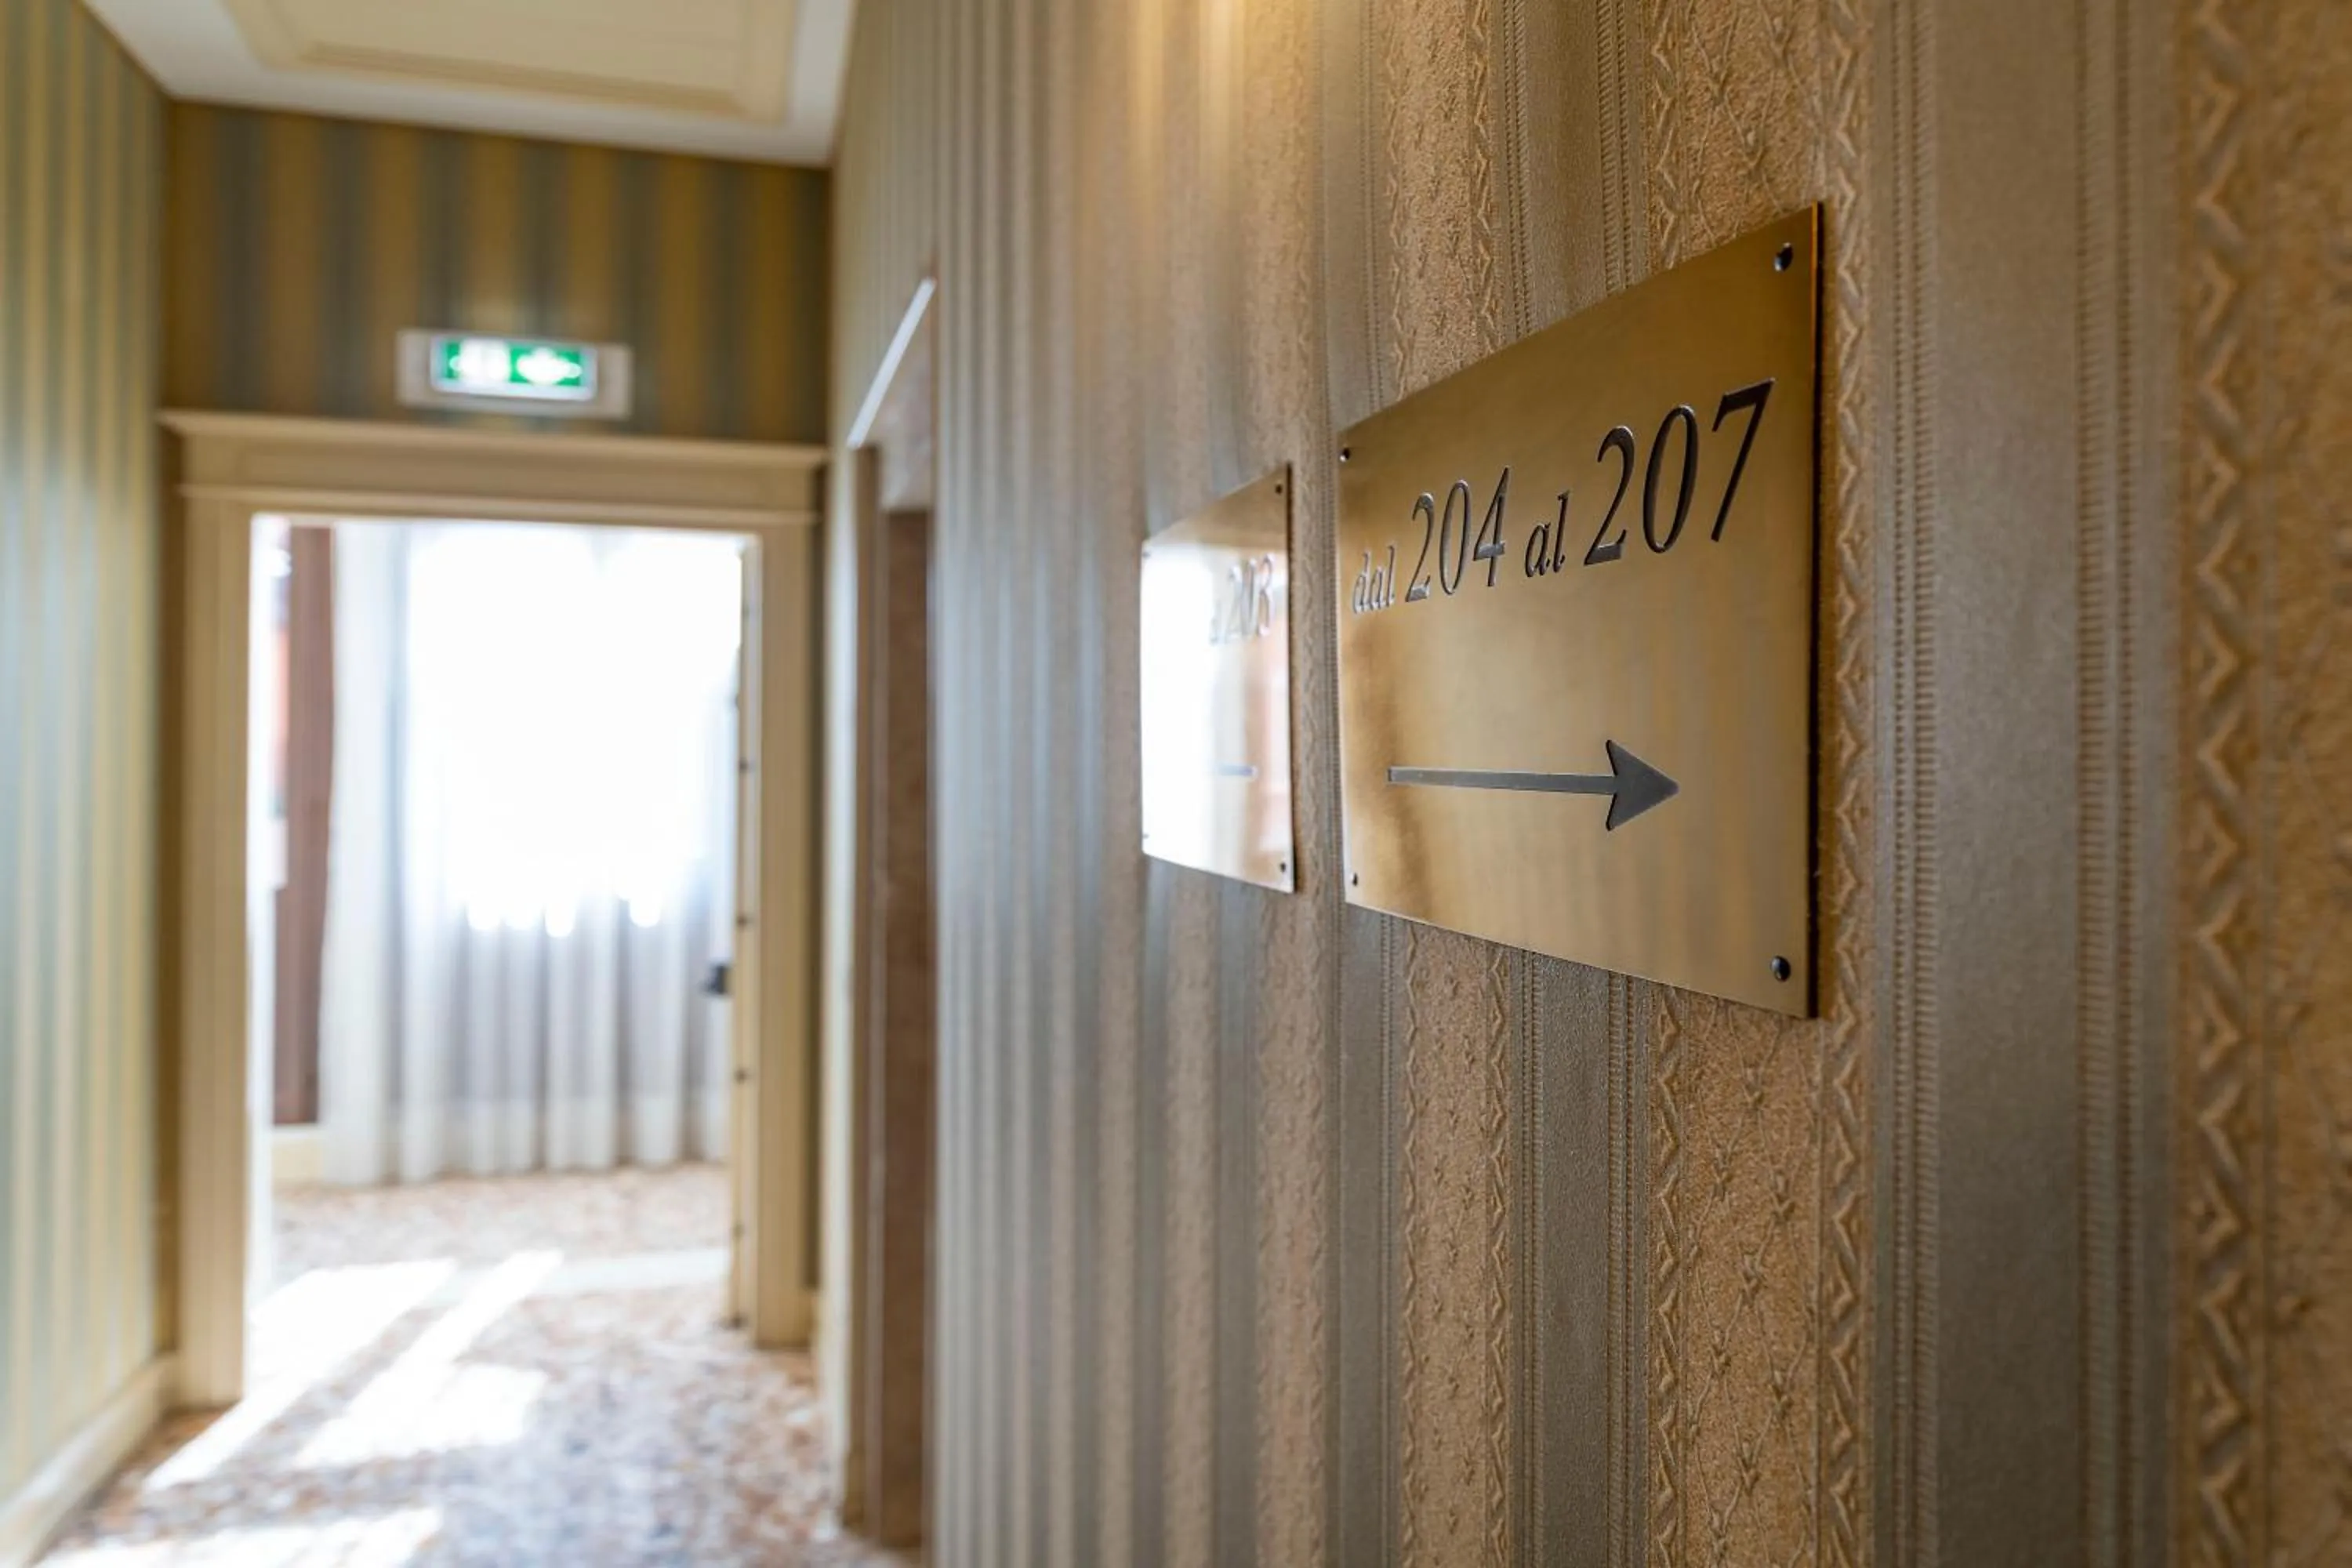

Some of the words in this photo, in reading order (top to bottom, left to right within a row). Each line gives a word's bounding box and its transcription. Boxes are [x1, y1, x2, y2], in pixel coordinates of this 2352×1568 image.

[1352, 546, 1396, 615] dal
[1405, 465, 1511, 603] 204
[1524, 490, 1570, 578] al
[1583, 377, 1775, 566] 207
